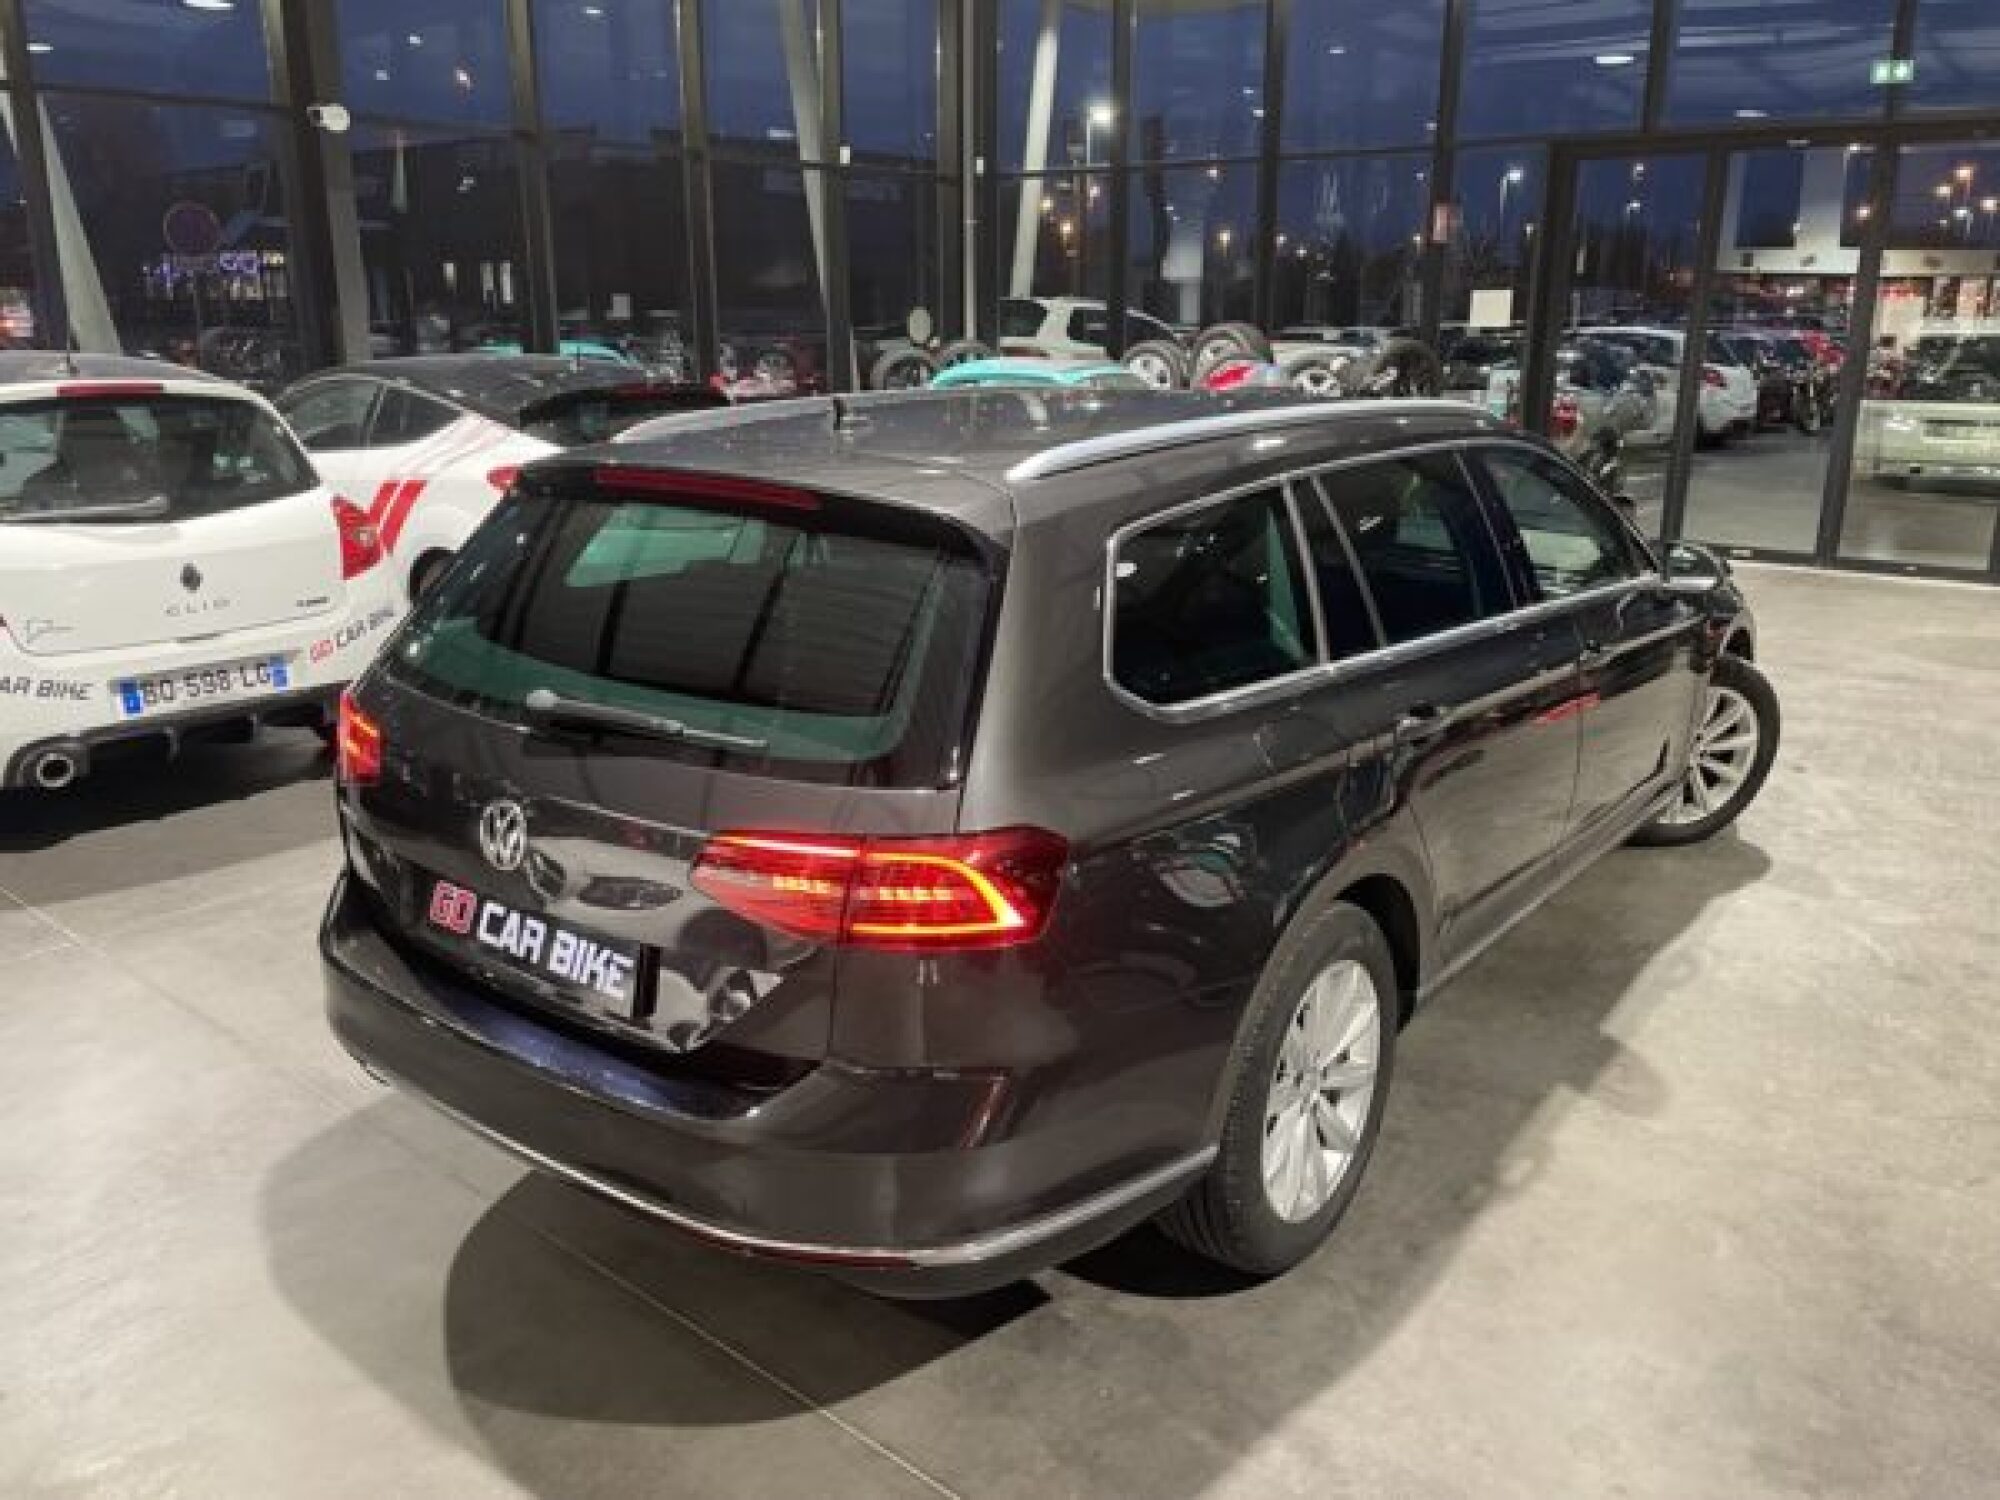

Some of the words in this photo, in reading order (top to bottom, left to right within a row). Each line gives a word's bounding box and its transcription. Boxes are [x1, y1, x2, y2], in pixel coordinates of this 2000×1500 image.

[336, 619, 367, 648] CAR
[37, 679, 94, 701] BIKE
[430, 880, 477, 934] GO
[477, 902, 547, 963] CAR
[547, 930, 634, 999] BIKE
